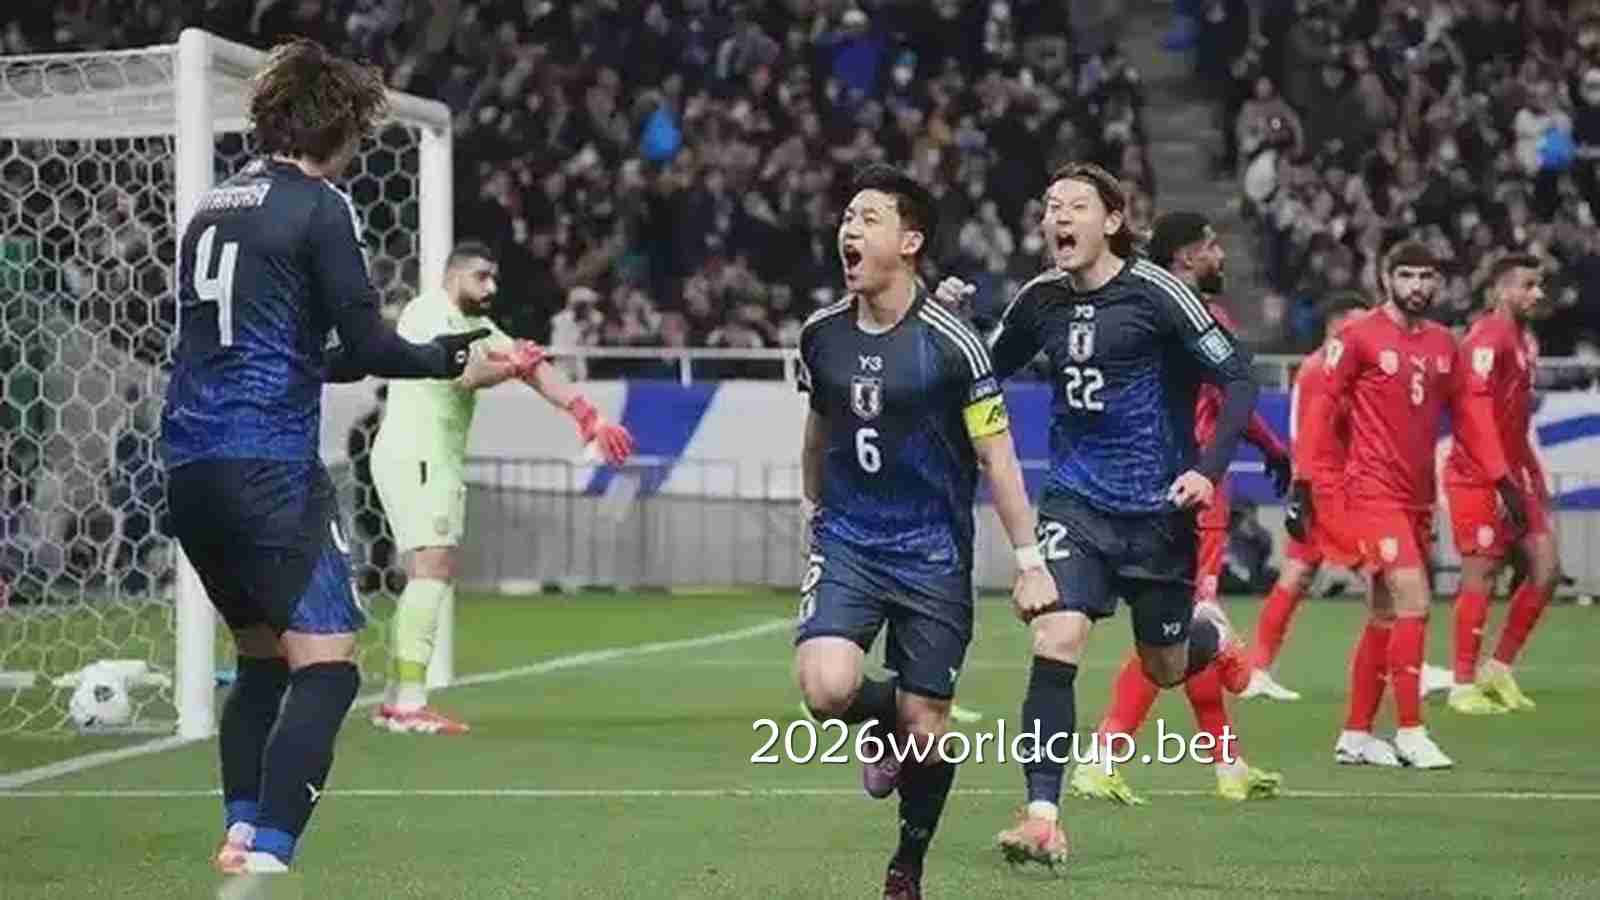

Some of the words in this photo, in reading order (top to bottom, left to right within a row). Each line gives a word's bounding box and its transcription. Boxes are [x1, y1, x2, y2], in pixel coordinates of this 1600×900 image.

[194, 224, 239, 347] 4
[1064, 367, 1104, 410] 22
[1410, 372, 1424, 406] 5
[856, 427, 881, 473] 6
[419, 460, 428, 486] 1
